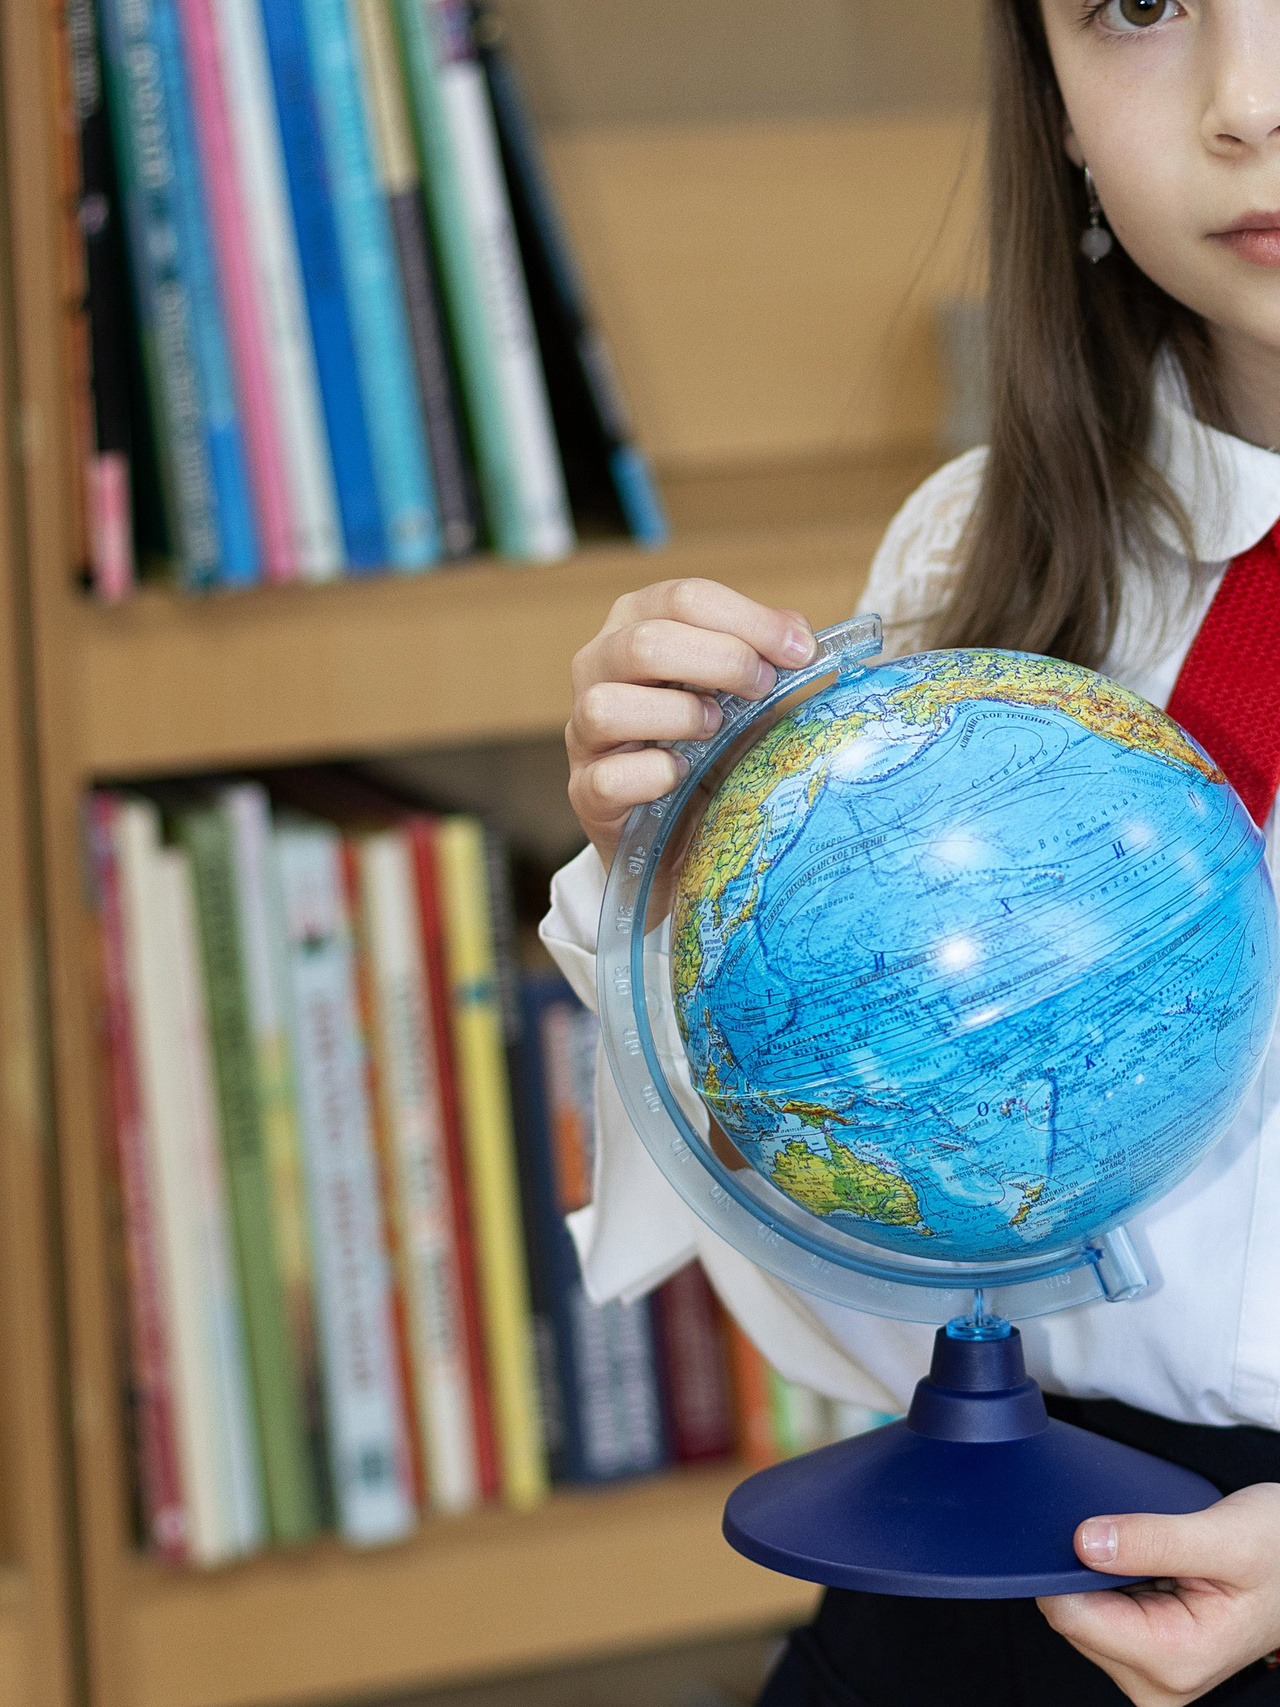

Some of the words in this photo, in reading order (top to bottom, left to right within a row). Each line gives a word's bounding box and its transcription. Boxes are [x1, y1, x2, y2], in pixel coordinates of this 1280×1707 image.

[960, 713, 1002, 750] АЛЯСКИНСКОЕ
[1006, 713, 1053, 726] ТЕЧЕНИЕ
[1097, 1149, 1127, 1167] МОСКВА
